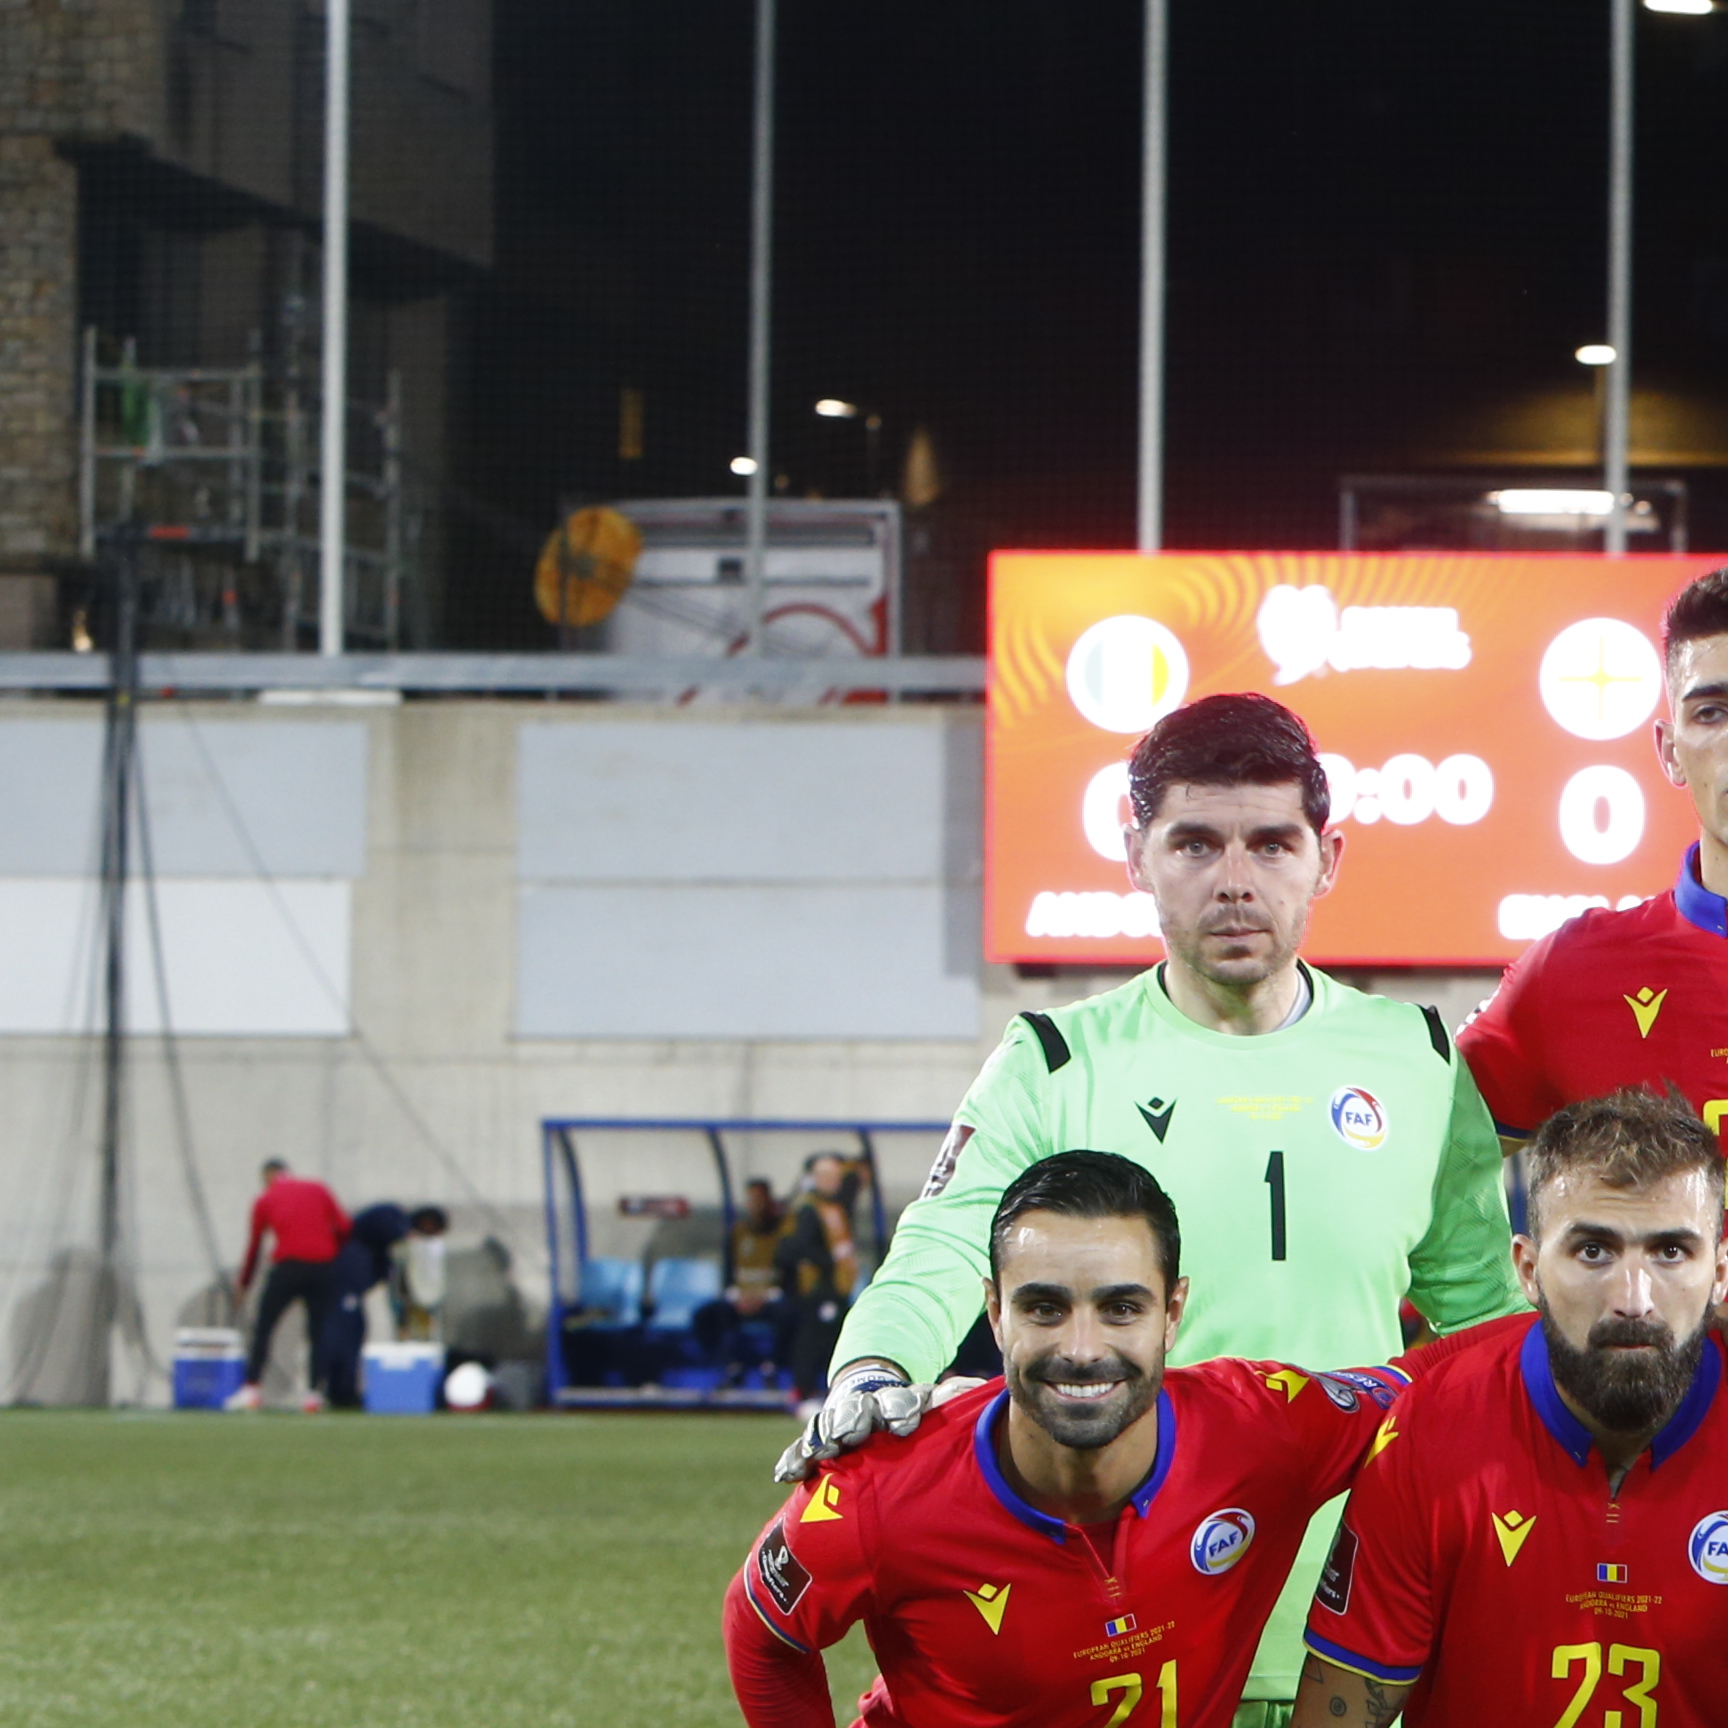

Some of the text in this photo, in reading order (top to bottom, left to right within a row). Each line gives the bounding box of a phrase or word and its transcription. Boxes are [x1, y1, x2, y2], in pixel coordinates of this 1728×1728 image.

[1559, 765, 1645, 864] 0
[1342, 1108, 1373, 1127] FAF
[1265, 1151, 1286, 1261] 1
[1208, 1530, 1239, 1558] FAF
[1598, 1591, 1636, 1603] QUALIFIERS
[1616, 1602, 1648, 1612] ENGLAND
[1073, 1620, 1175, 1659] EUROPEAN QUALIFIERS 2021-22
[1090, 1647, 1122, 1660] ANDORRA
[1131, 1634, 1162, 1649] ENGLAND
